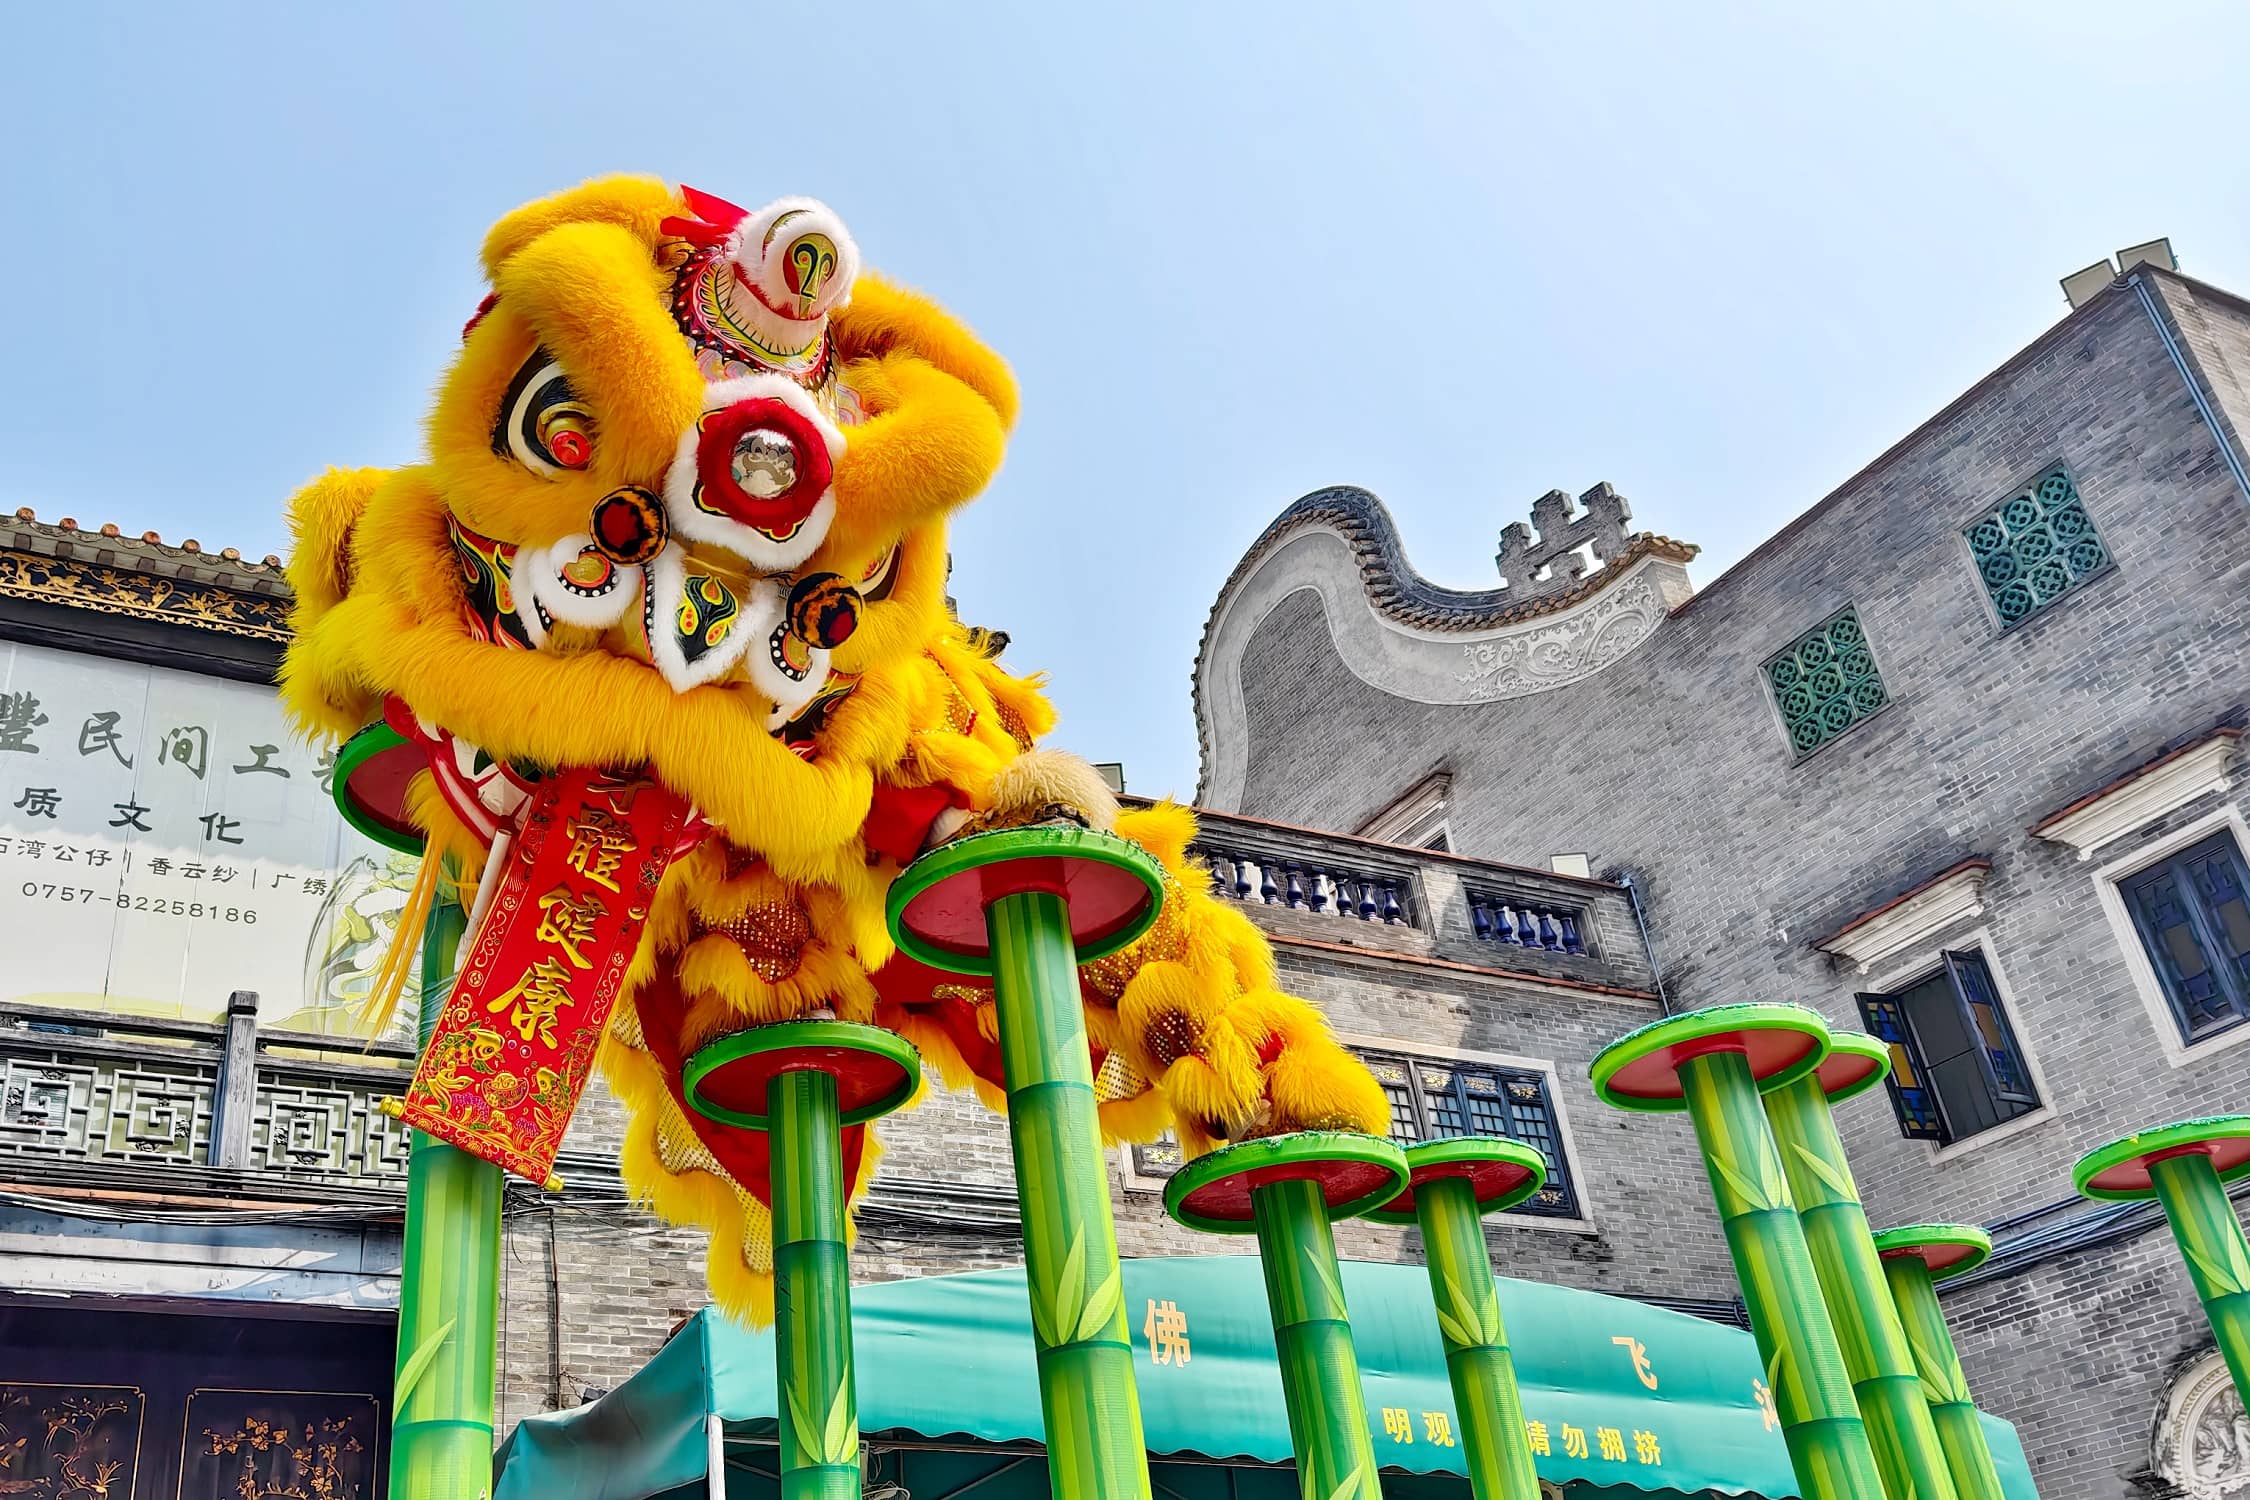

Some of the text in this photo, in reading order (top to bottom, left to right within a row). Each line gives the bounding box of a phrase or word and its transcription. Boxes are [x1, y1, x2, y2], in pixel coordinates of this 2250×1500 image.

[13, 787, 245, 845] 质文化
[22, 881, 257, 924] 0757-82258186
[147, 857, 239, 883] 香云纱
[271, 873, 328, 896] 广绣
[1143, 1298, 1191, 1368] 佛
[1365, 1407, 1662, 1466] 明观 请勿拥挤
